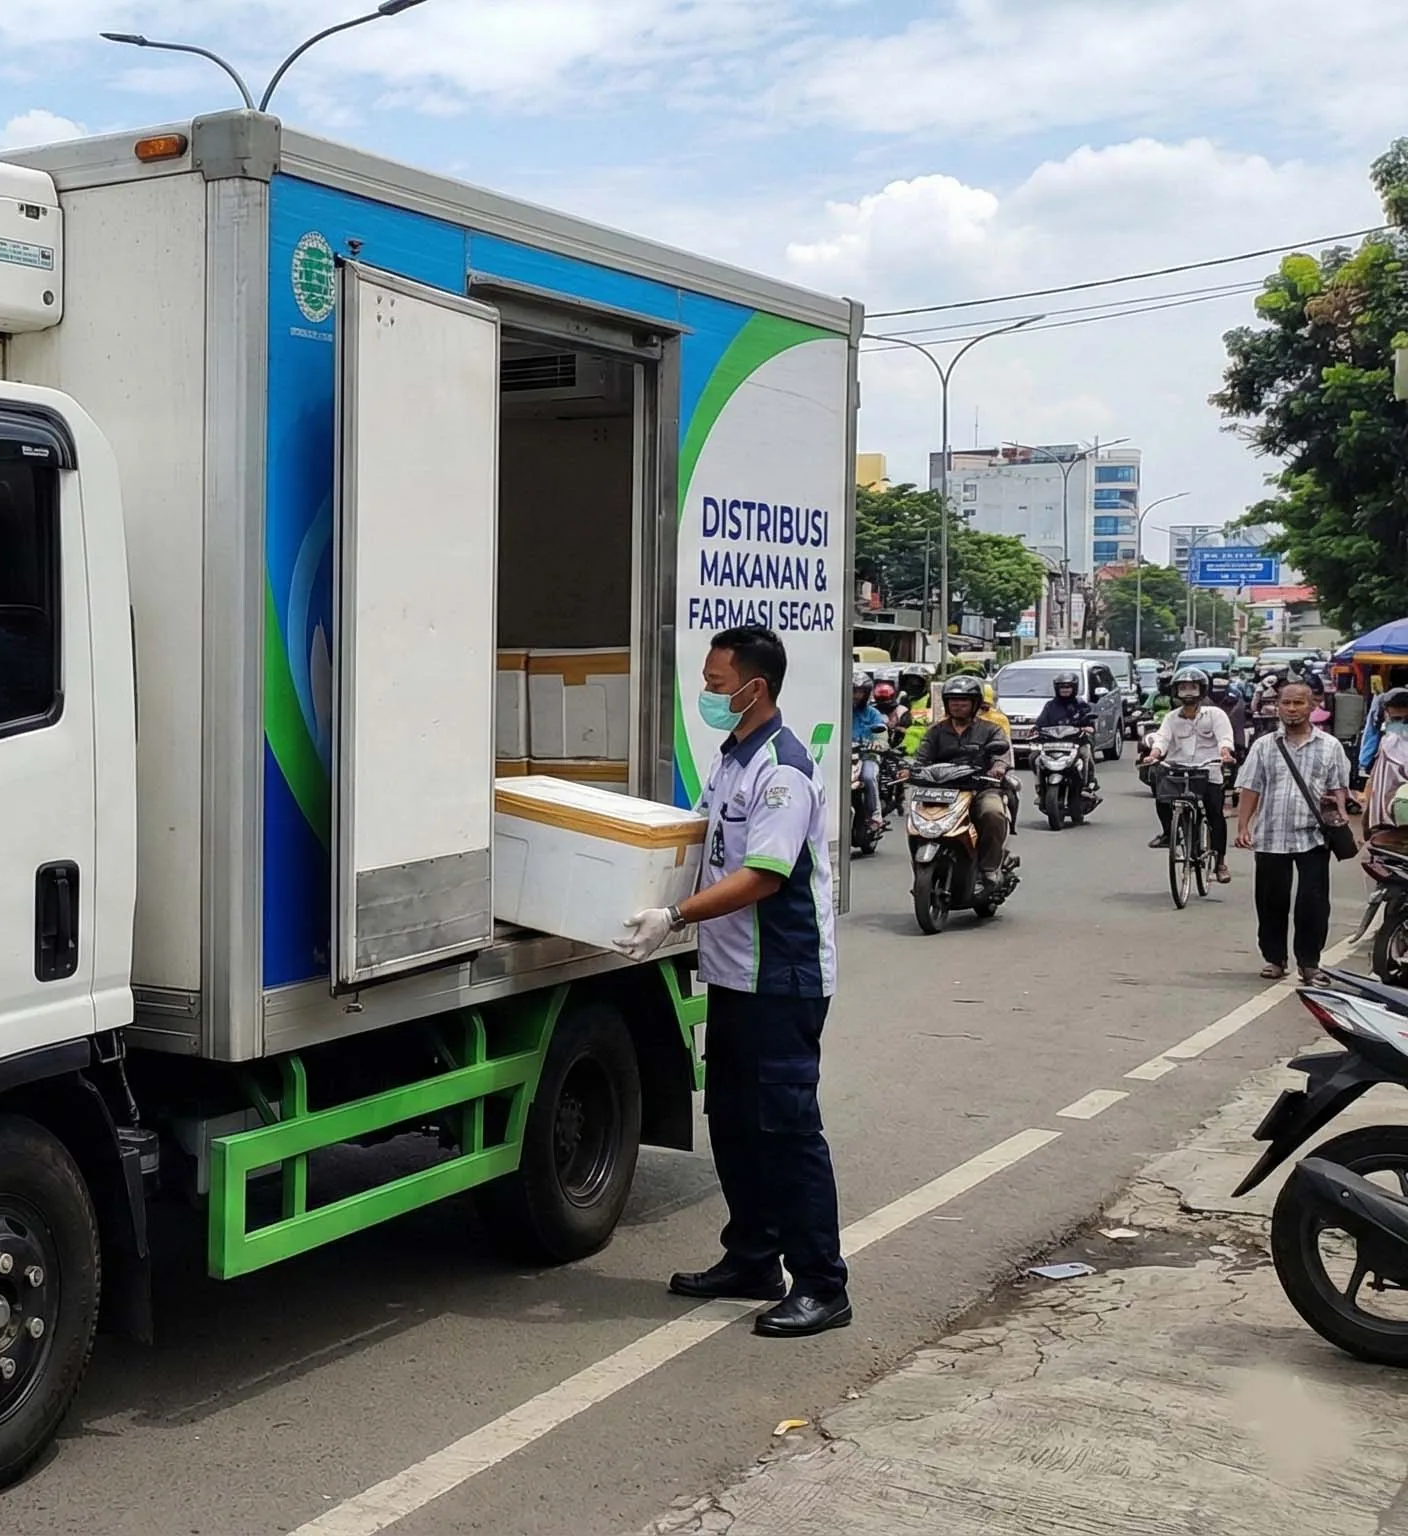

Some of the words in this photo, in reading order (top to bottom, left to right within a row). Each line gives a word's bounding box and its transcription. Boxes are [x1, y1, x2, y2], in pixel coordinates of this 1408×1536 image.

[702, 496, 829, 548] DISTRIBUSI
[700, 549, 809, 591] MAKANAN
[814, 558, 828, 592] &
[689, 597, 774, 630] FARMASI
[778, 601, 835, 632] SEGAR
